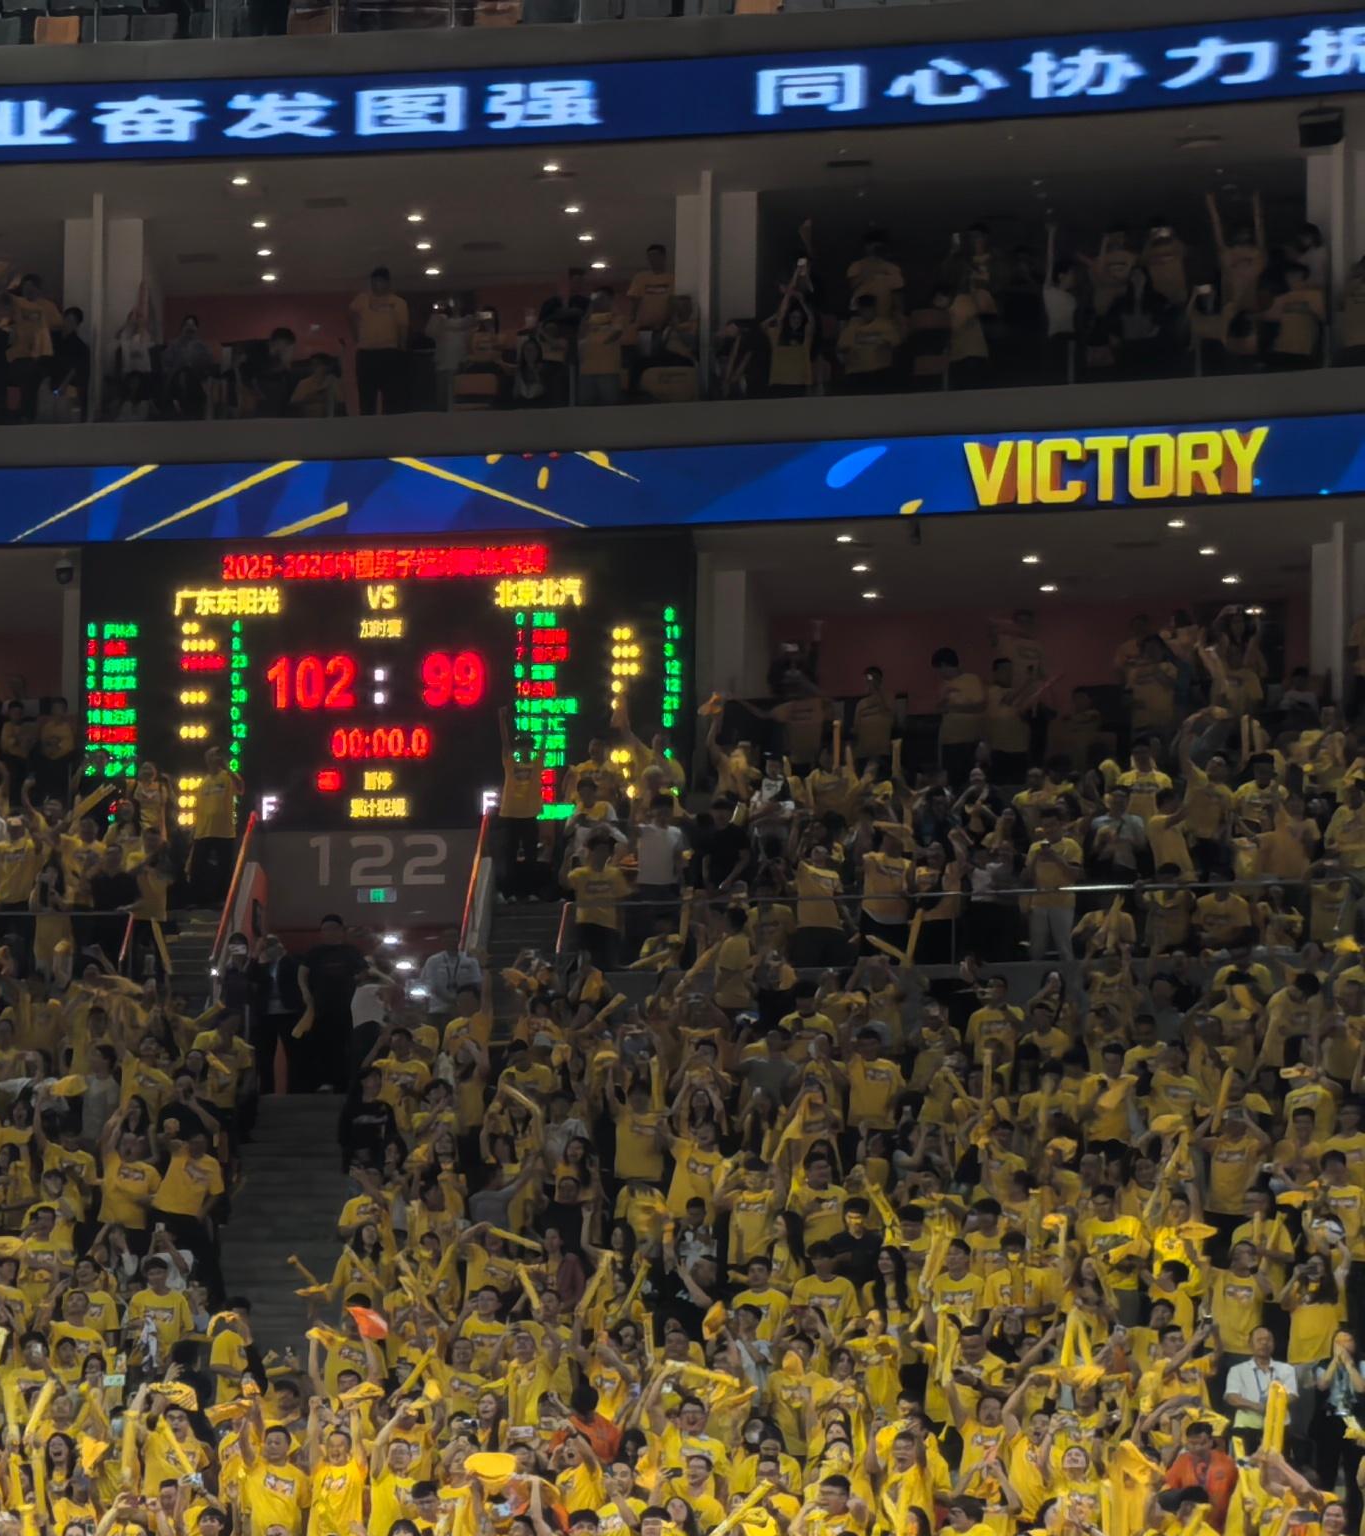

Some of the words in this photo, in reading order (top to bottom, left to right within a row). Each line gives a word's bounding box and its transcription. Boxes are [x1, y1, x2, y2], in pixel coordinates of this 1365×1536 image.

[963, 427, 1269, 506] VICTORY
[175, 586, 281, 615] 广东东阳光
[367, 585, 397, 609] VS
[494, 578, 583, 607] 北京北汽
[231, 654, 248, 669] 23
[267, 656, 356, 709] 102
[423, 652, 485, 707] 99
[331, 728, 429, 759] 00:00.0
[262, 796, 280, 821] F
[482, 791, 498, 816] F
[309, 834, 447, 886] 122
